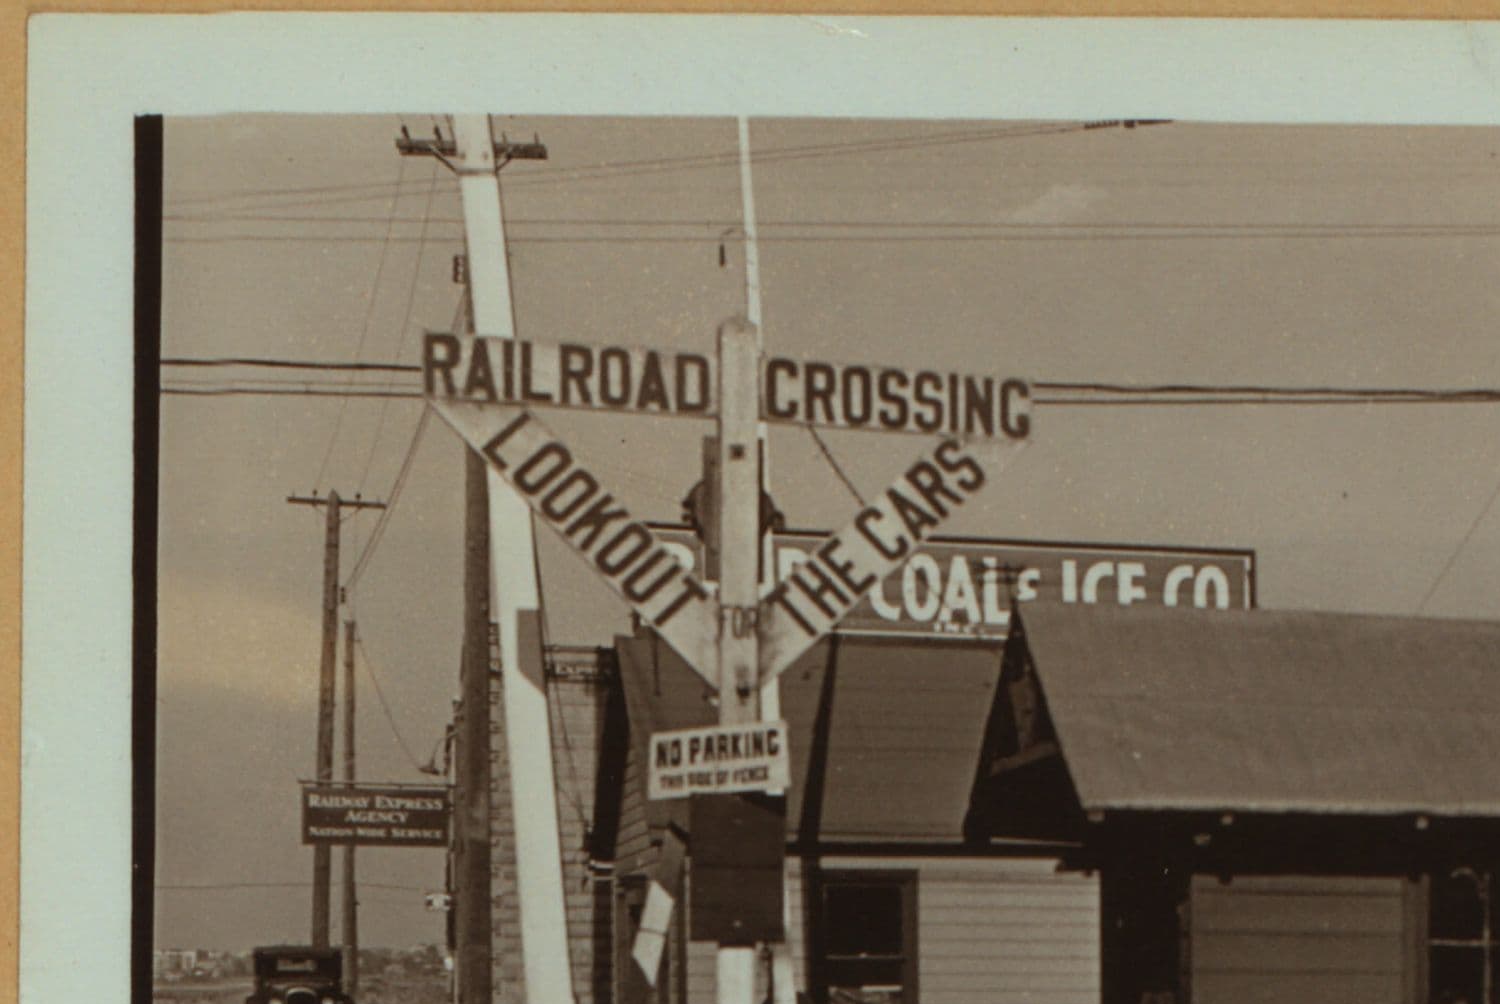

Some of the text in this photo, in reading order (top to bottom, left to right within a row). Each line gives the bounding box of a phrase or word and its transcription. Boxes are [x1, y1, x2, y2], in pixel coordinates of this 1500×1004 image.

[424, 333, 1031, 440] RAILROAD CROSSING
[763, 537, 877, 637] THE
[855, 438, 987, 560] CARS
[1061, 559, 1147, 605] ICE
[655, 728, 780, 769] NO PARKING
[308, 793, 444, 811] RAILWAY EXPRESS
[344, 810, 409, 824] AGENCY
